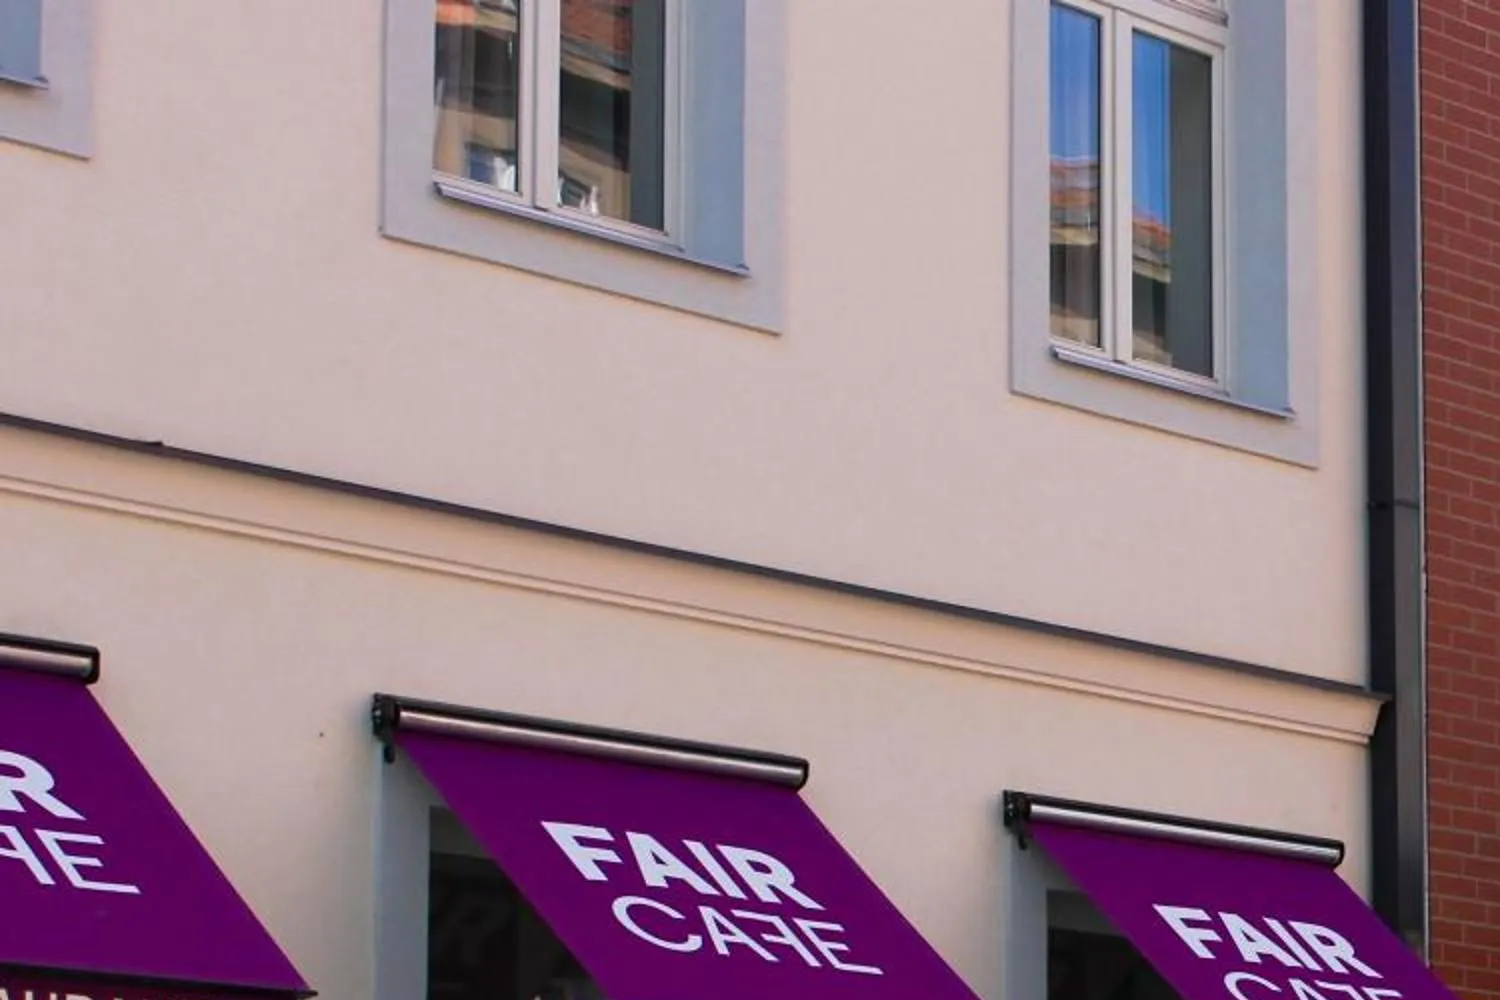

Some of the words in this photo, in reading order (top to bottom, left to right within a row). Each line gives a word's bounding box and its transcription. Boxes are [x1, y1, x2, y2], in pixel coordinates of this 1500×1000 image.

[540, 820, 825, 911] FAIR
[610, 895, 884, 976] CAFE
[1152, 903, 1384, 979] FAIR
